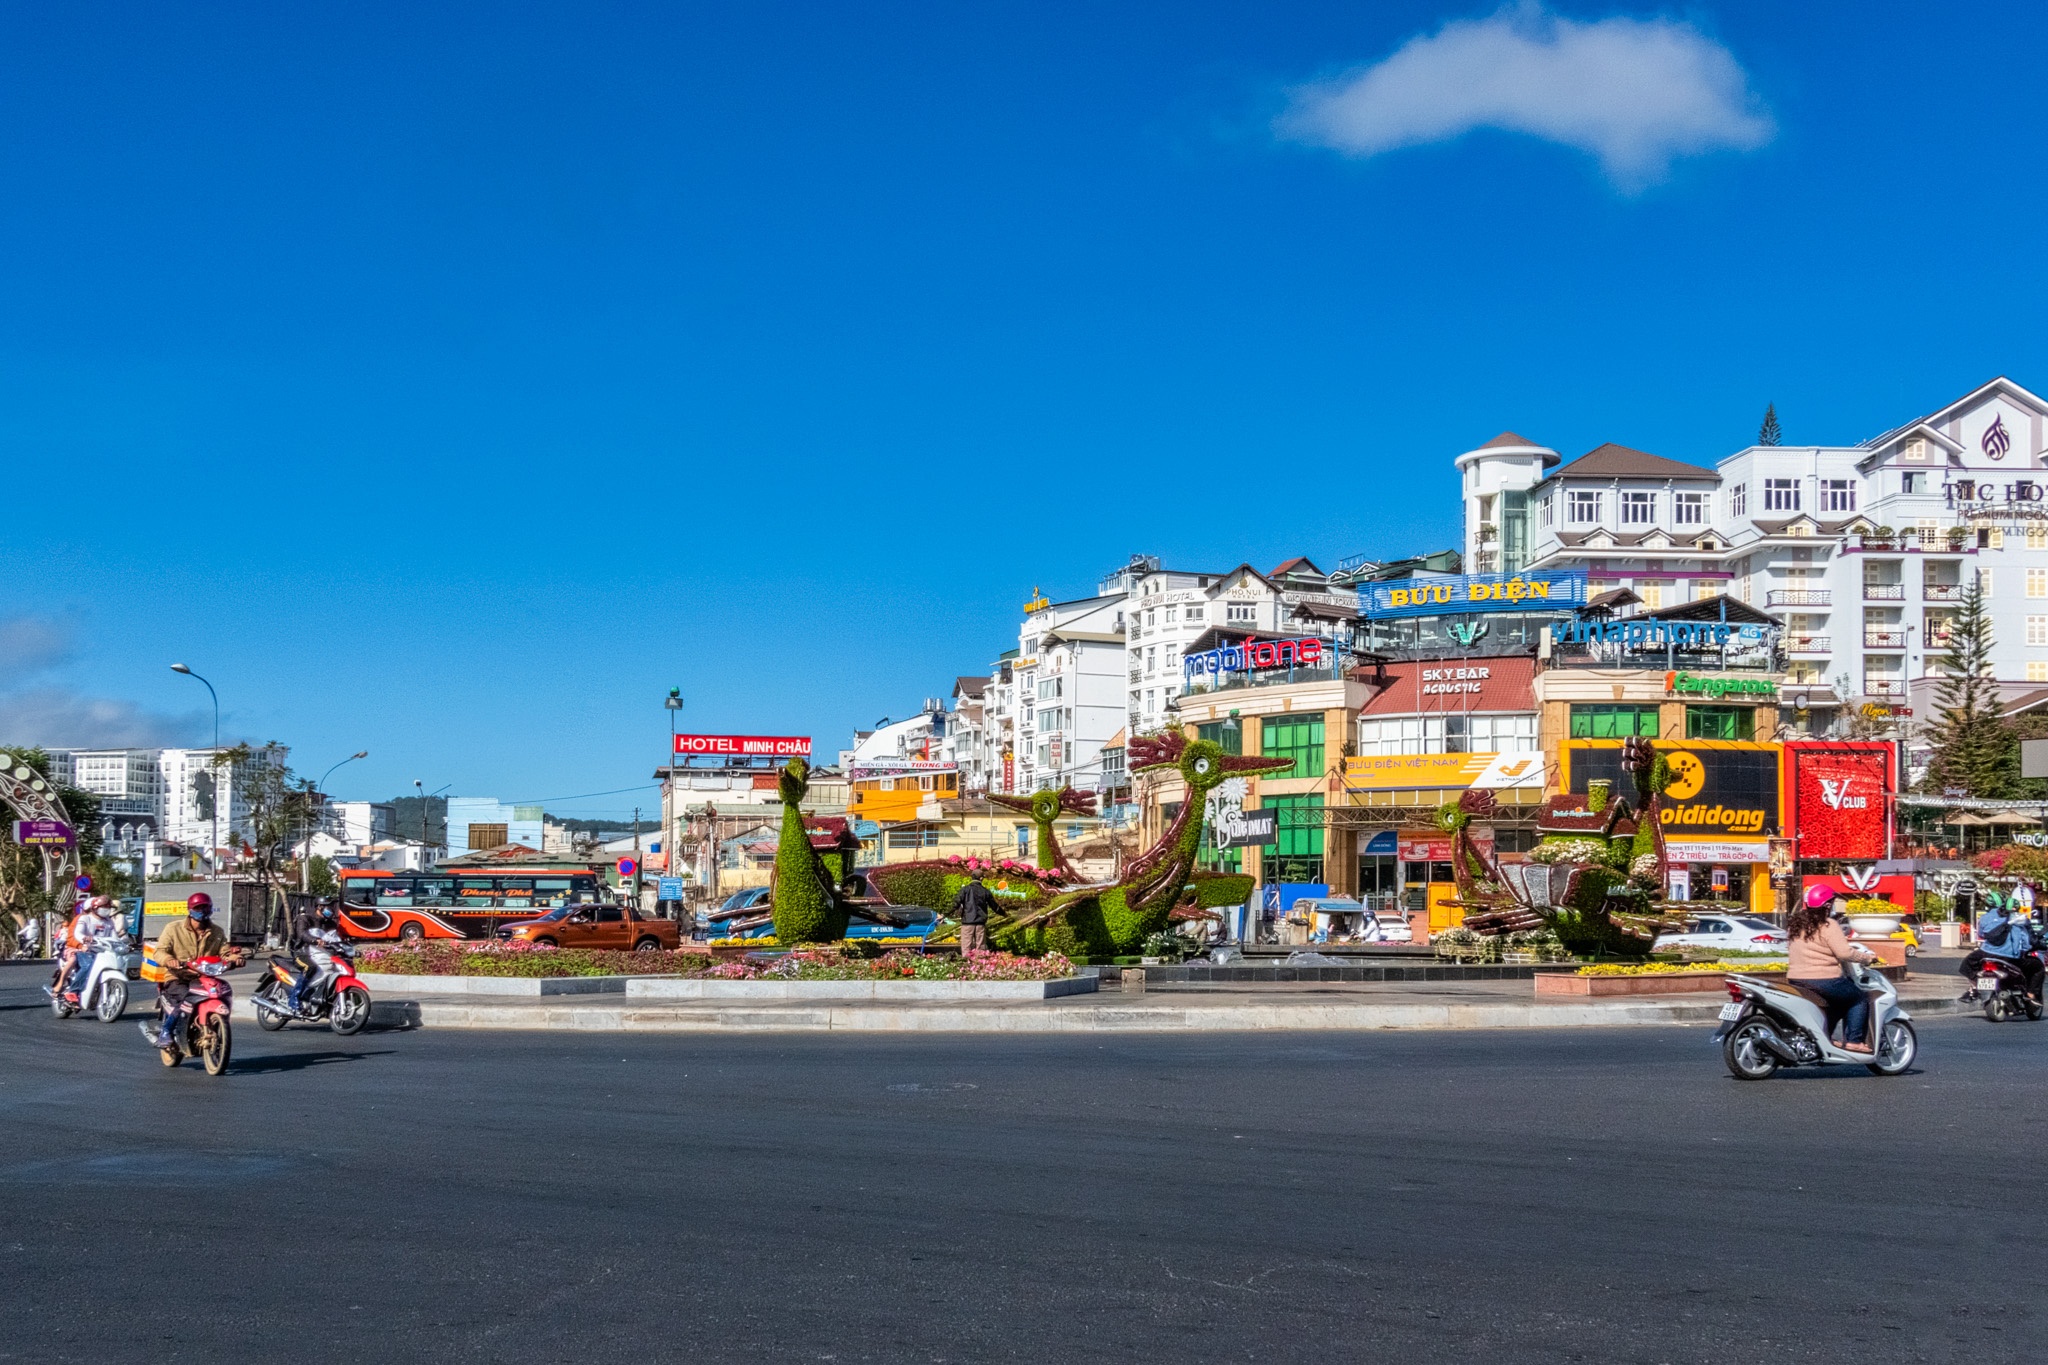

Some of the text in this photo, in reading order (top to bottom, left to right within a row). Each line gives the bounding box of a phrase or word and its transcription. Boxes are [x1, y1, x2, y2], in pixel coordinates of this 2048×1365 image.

[2004, 484, 2048, 501] HO
[1390, 577, 1550, 606] BƯU ĐIỆN
[1551, 617, 1732, 648] vinaphone
[1184, 636, 1322, 678] mobifone
[1423, 683, 1481, 694] ACOUSTIC
[680, 737, 811, 753] HOTEL MINH CHÂU
[1432, 758, 1459, 767] NAM
[1843, 796, 1867, 808] CLUB
[1679, 851, 1685, 859] 2
